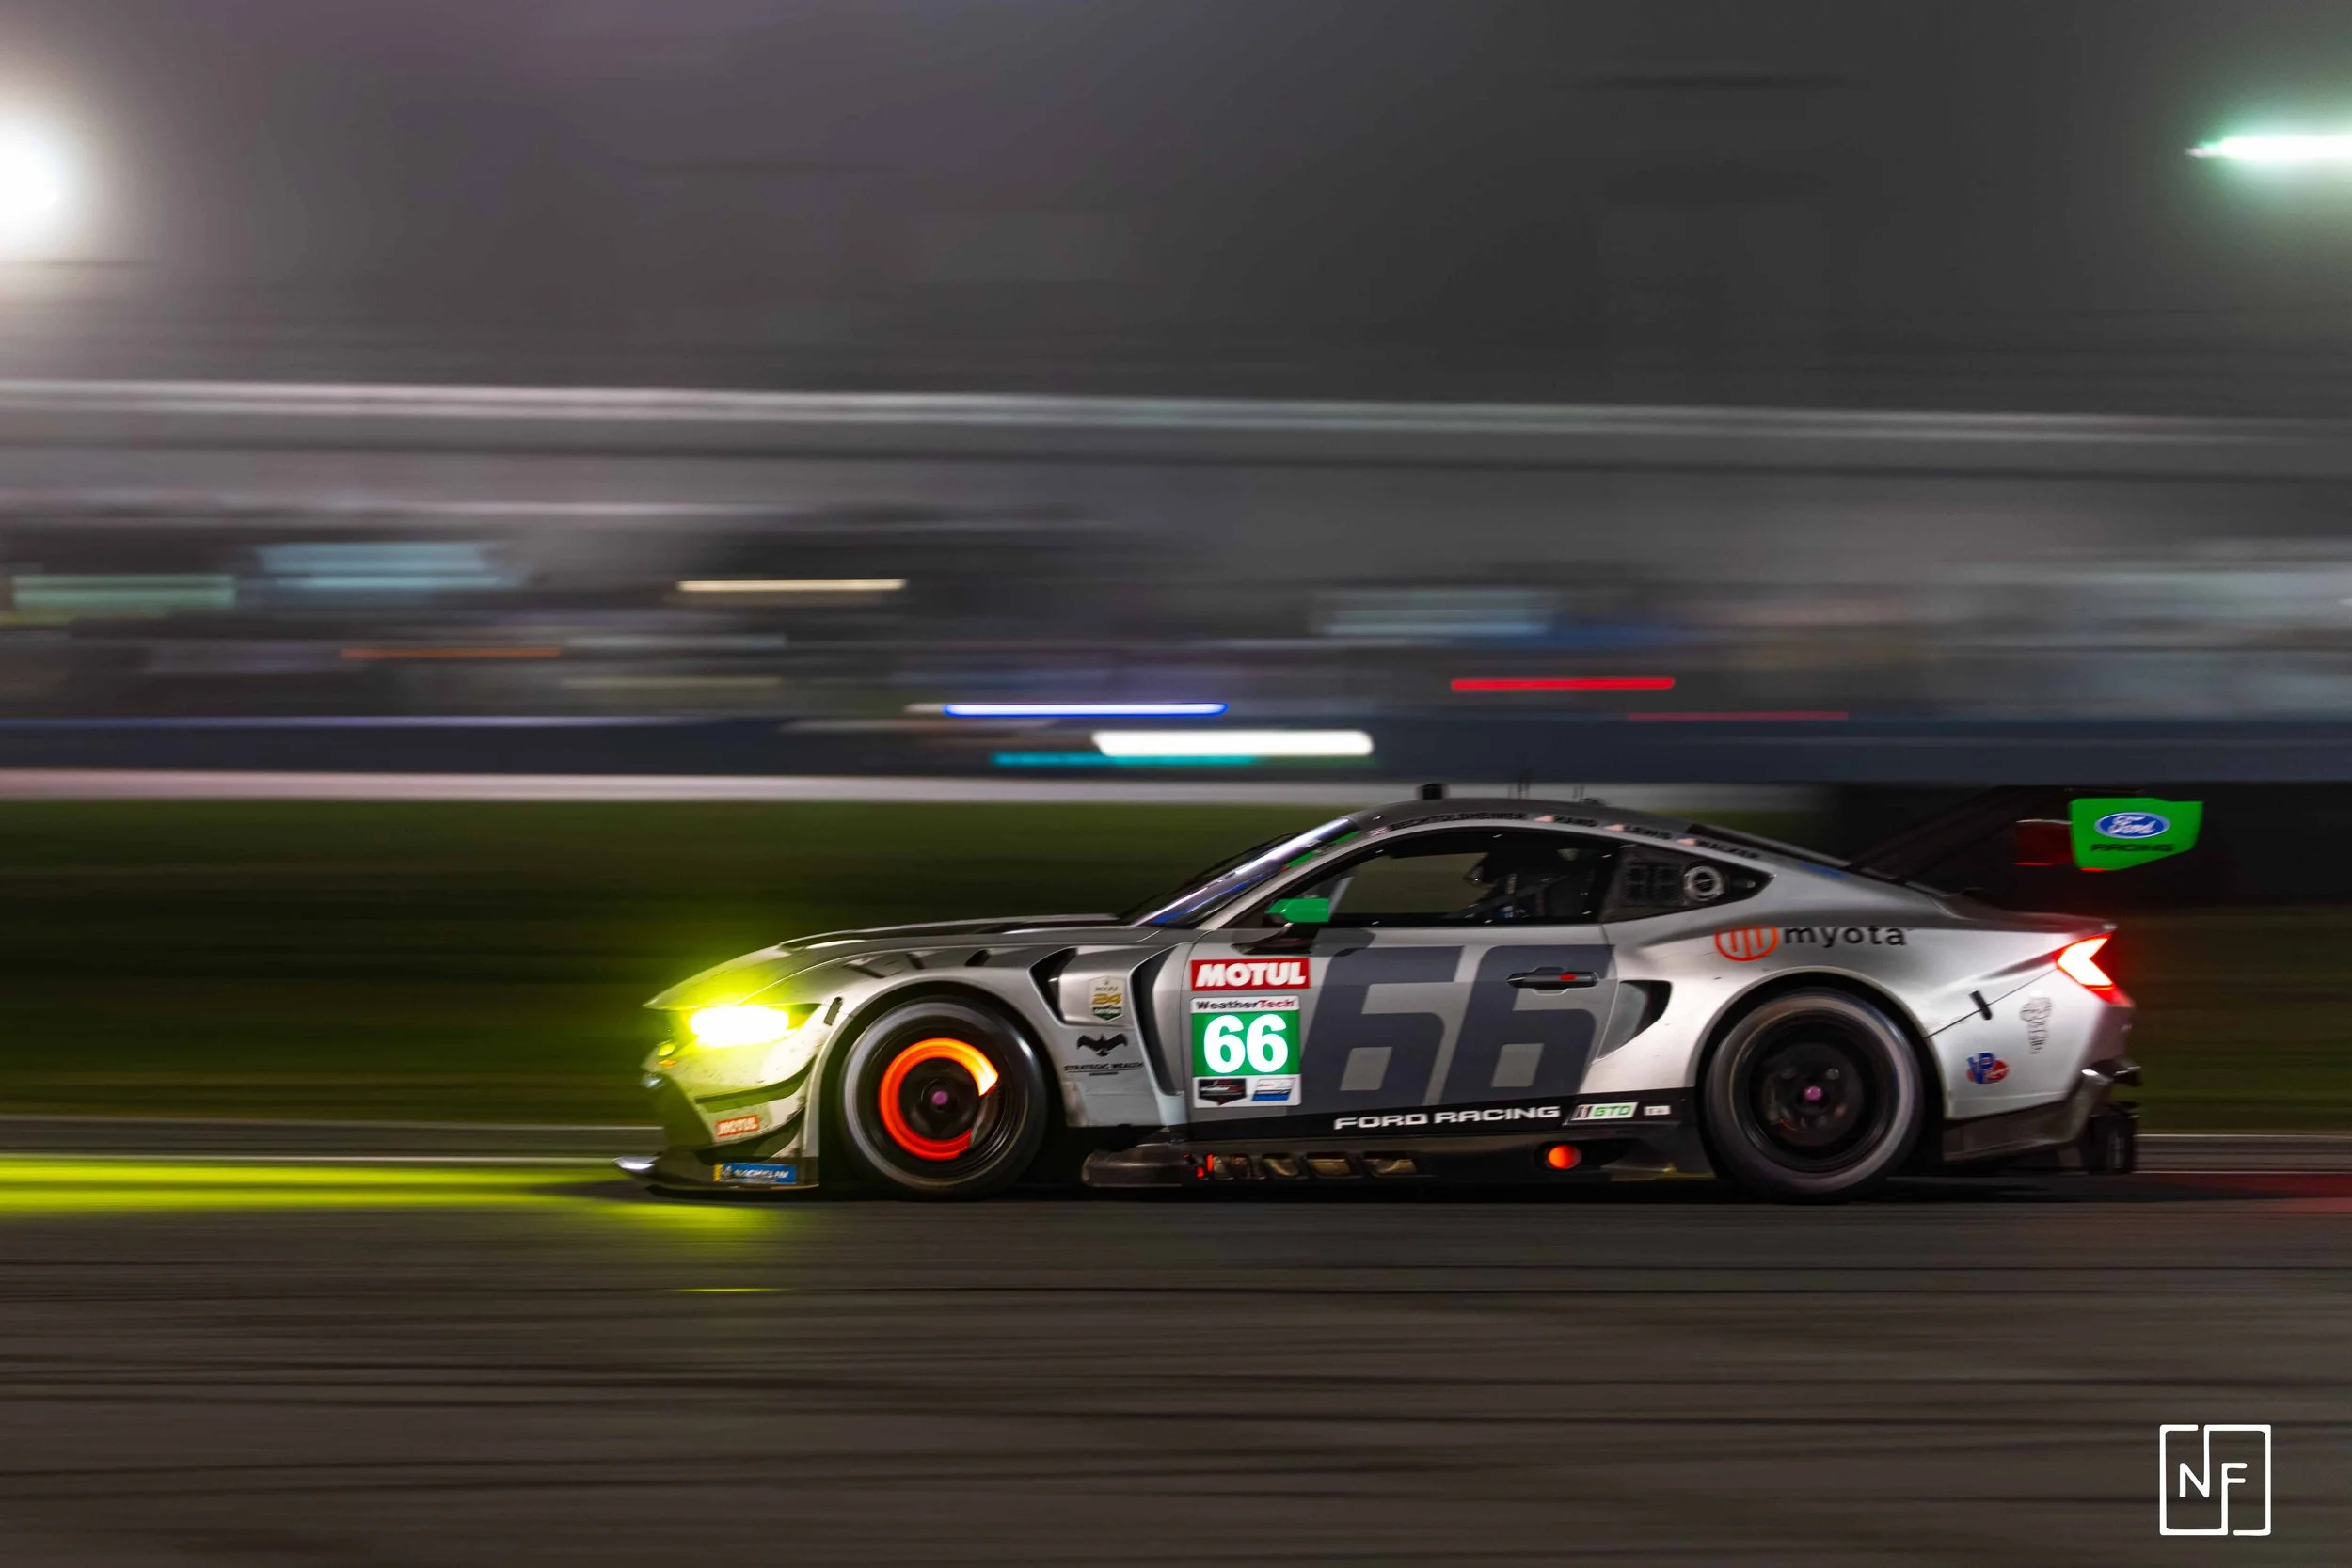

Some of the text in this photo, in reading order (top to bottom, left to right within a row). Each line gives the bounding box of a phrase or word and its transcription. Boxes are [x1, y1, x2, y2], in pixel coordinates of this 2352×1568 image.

[2107, 815, 2157, 834] Ford
[1785, 925, 1906, 948] myota
[1195, 962, 1306, 987] MOTUL
[1196, 999, 1295, 1009] WeatherTech
[1289, 945, 1614, 1114] 66
[1203, 1014, 1288, 1073] 66
[1334, 1105, 1561, 1130] FORD RACING
